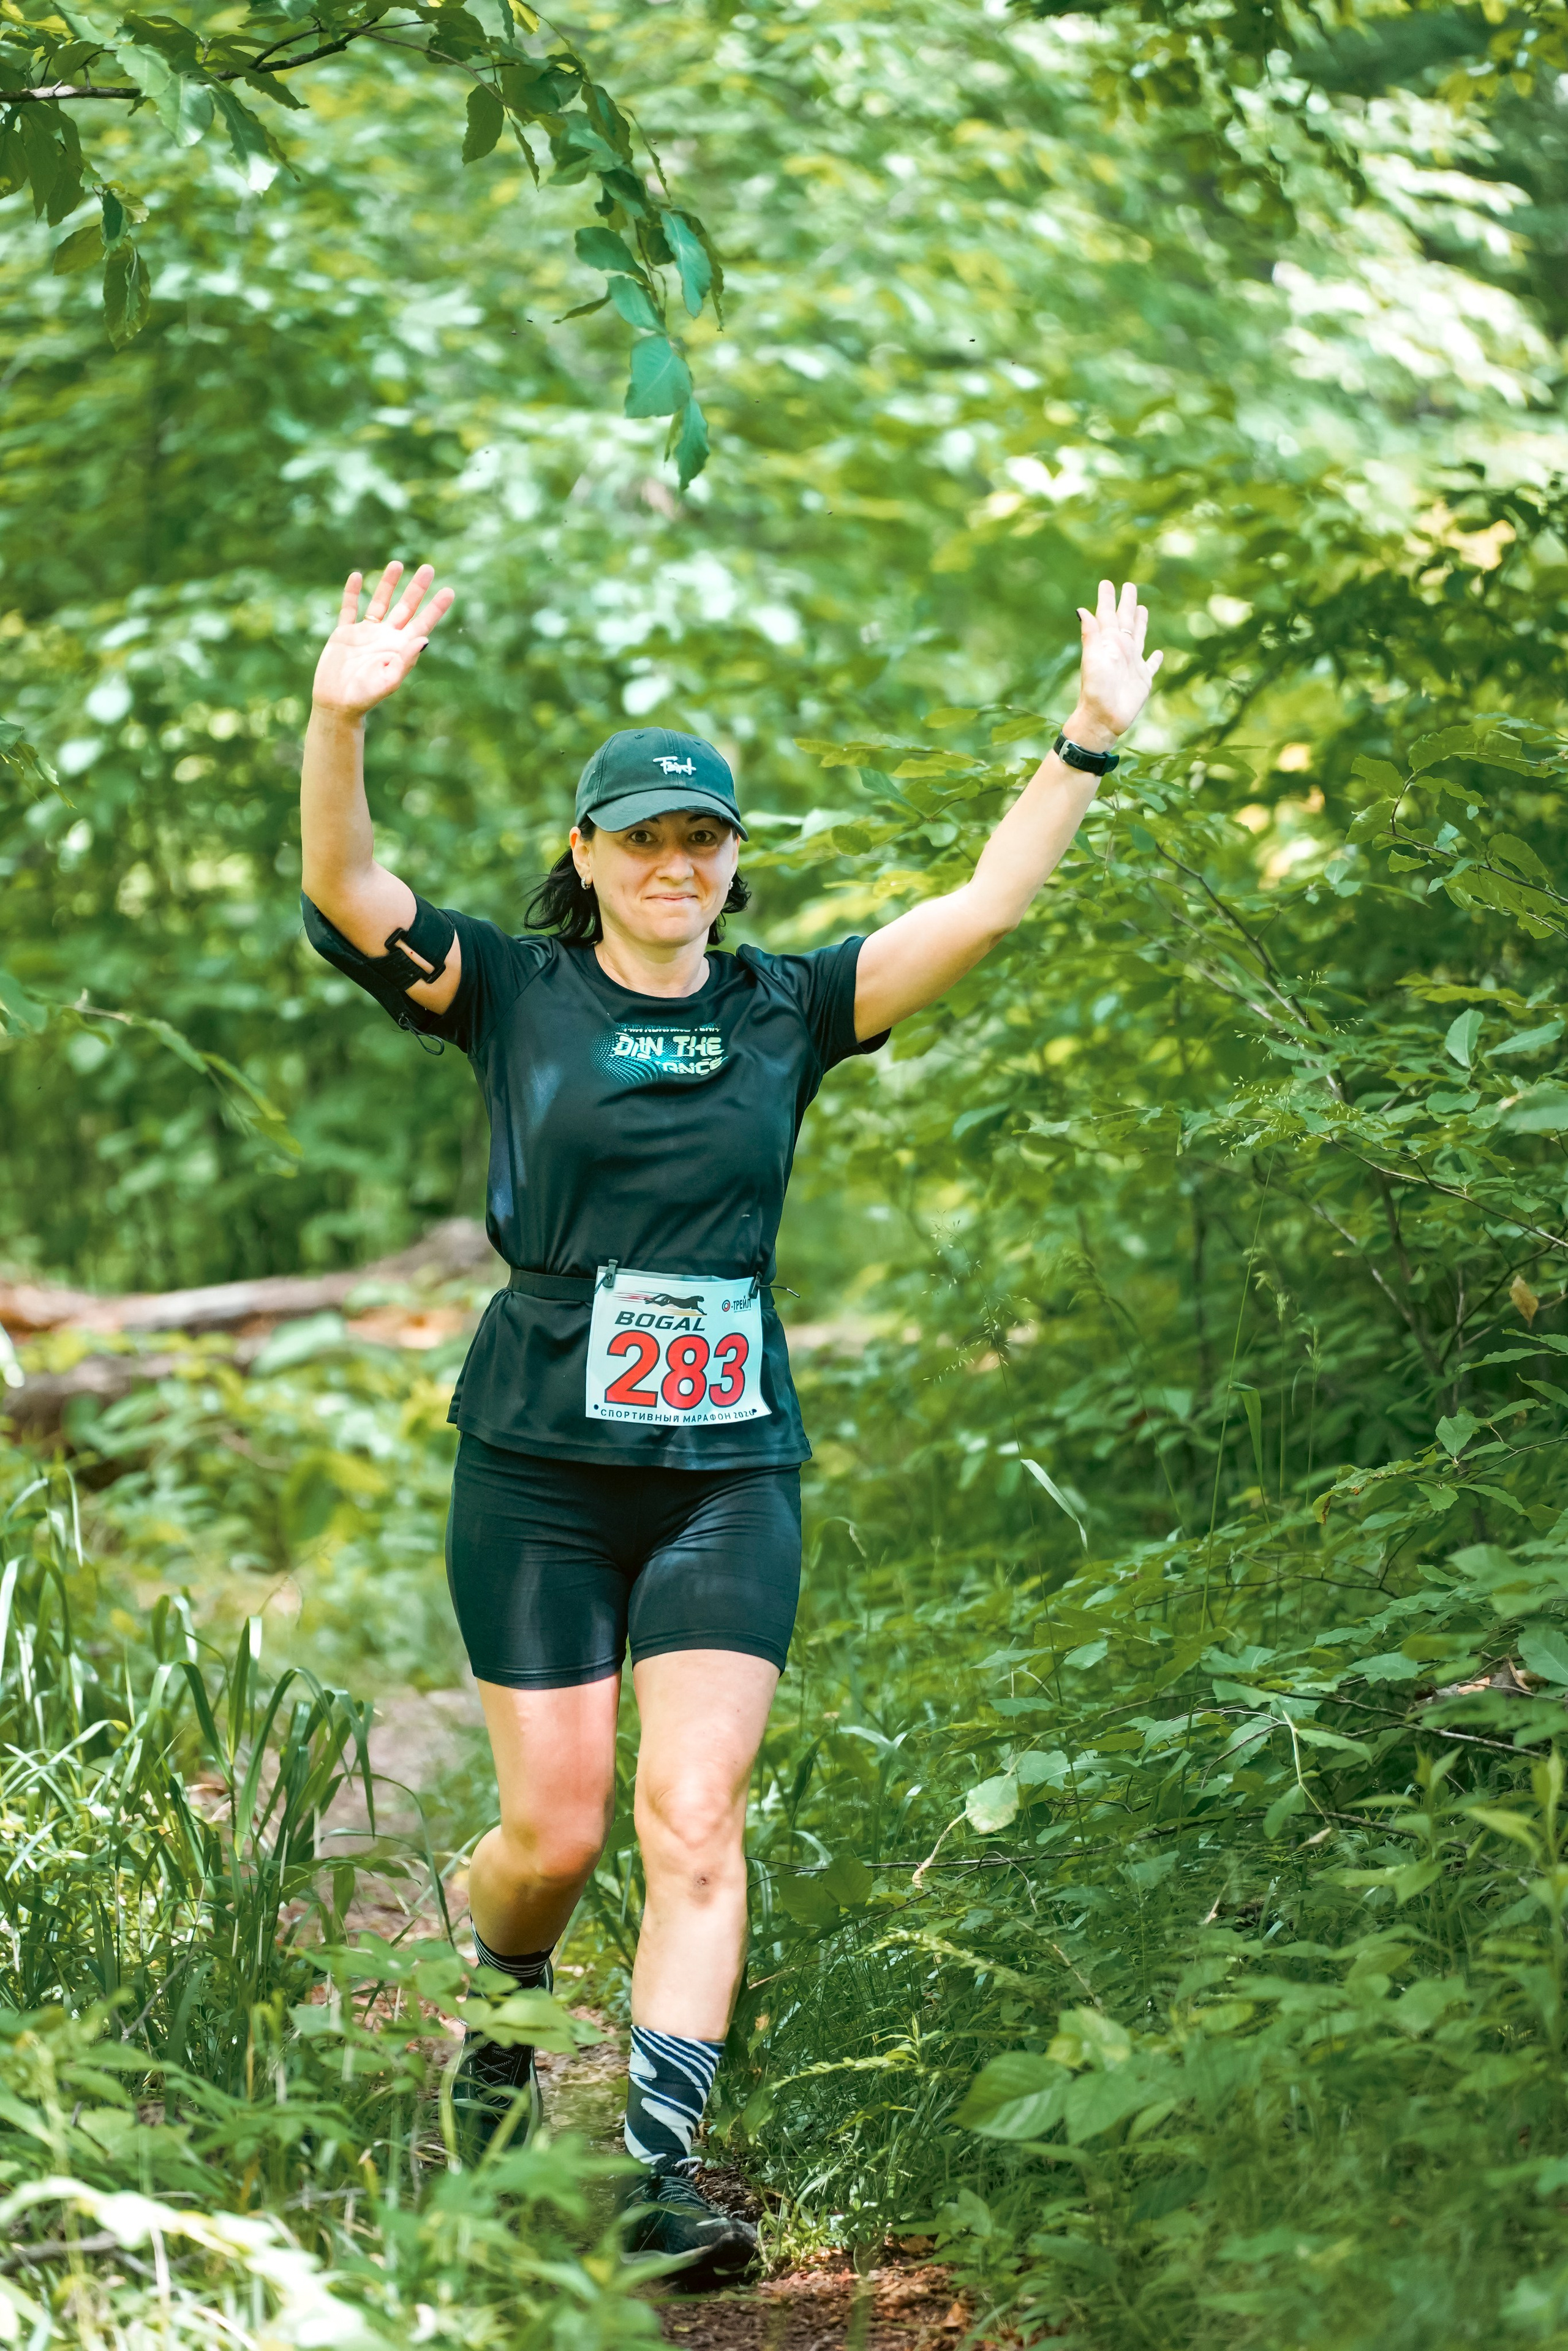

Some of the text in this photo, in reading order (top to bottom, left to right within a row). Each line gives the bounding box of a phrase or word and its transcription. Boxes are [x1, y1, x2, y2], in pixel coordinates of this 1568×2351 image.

[614, 1311, 706, 1331] BOGAL
[604, 1329, 749, 1411] 283
[600, 1409, 679, 1422] СПОРТИВНЫЙ
[683, 1413, 731, 1422] МАРАФОН
